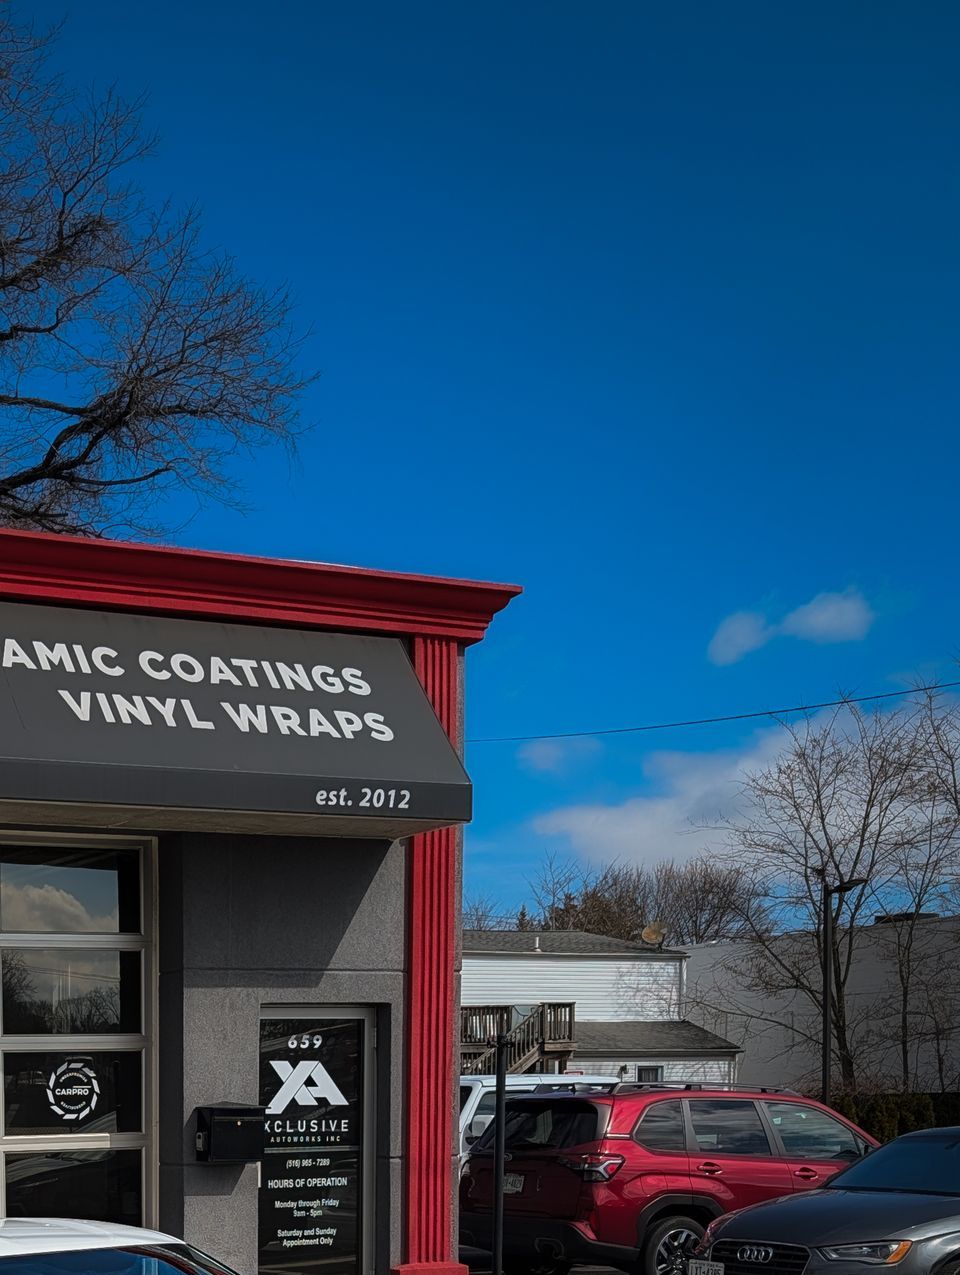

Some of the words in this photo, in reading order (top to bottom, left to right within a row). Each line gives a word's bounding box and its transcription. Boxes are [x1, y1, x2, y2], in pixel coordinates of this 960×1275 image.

[138, 650, 372, 696] COATINGS
[58, 689, 215, 730] VINYL
[221, 701, 395, 742] WRAPS
[315, 786, 353, 808] est.
[359, 786, 411, 810] 2012
[287, 1034, 323, 1049] 659
[271, 1135, 322, 1143] AUTOWORKS
[268, 1179, 294, 1189] HOURS
[295, 1178, 305, 1187] OF
[306, 1177, 347, 1187] OPERATION
[275, 1200, 298, 1209] Monday
[298, 1199, 321, 1208] through
[321, 1199, 339, 1207] Friday
[310, 1209, 322, 1217] 5pm
[277, 1229, 303, 1238] Saturday
[304, 1228, 315, 1236] and
[315, 1227, 337, 1236] Sunday
[283, 1238, 319, 1248] Appointment
[320, 1237, 333, 1245] Only
